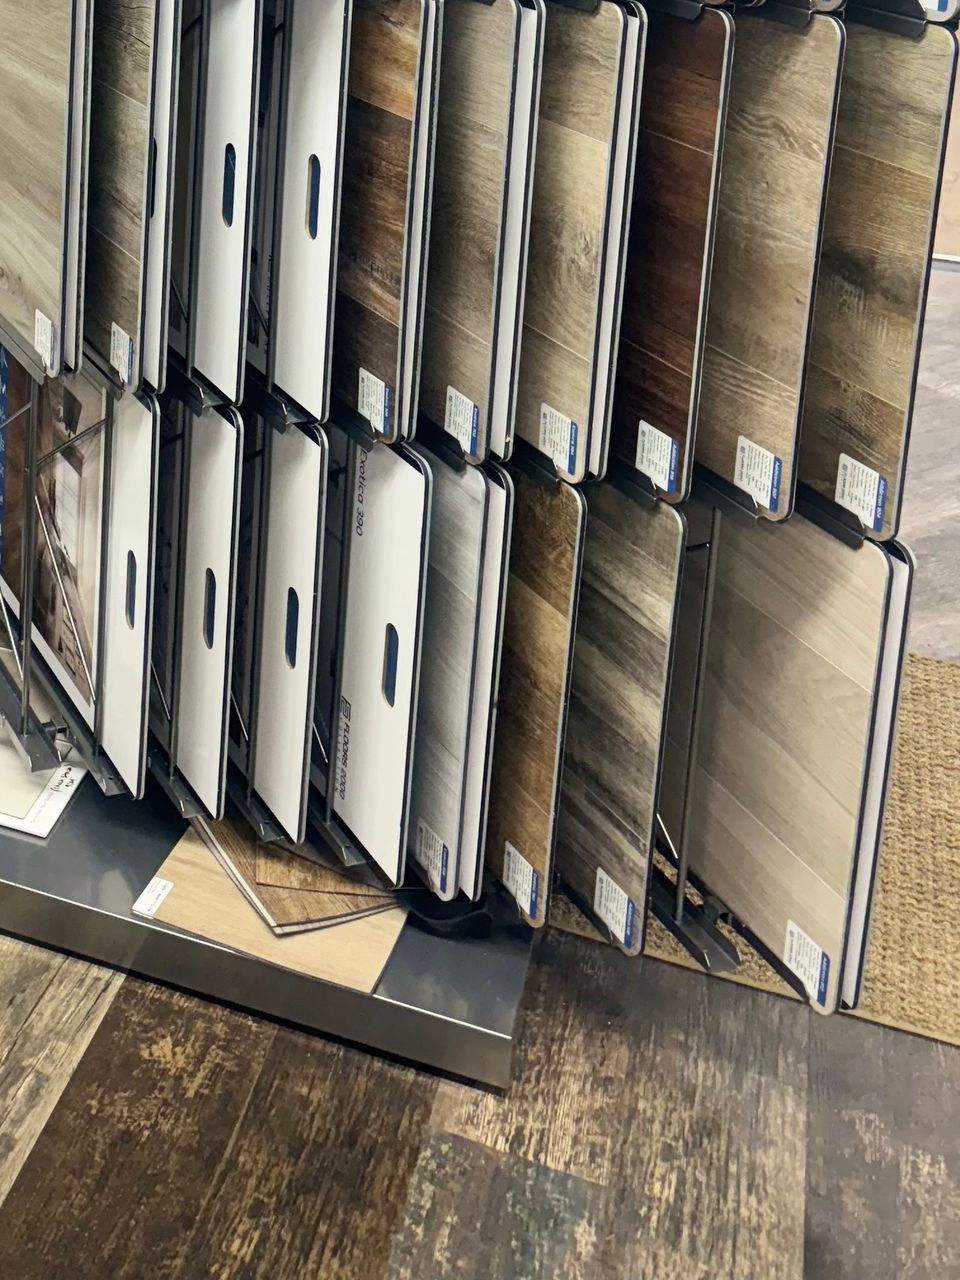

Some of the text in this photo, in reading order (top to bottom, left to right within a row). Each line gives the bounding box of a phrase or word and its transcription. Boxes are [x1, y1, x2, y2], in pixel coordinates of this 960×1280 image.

[356, 448, 368, 536] Exotica 390
[342, 722, 350, 768] FLOORS
[339, 768, 347, 800] 2000
